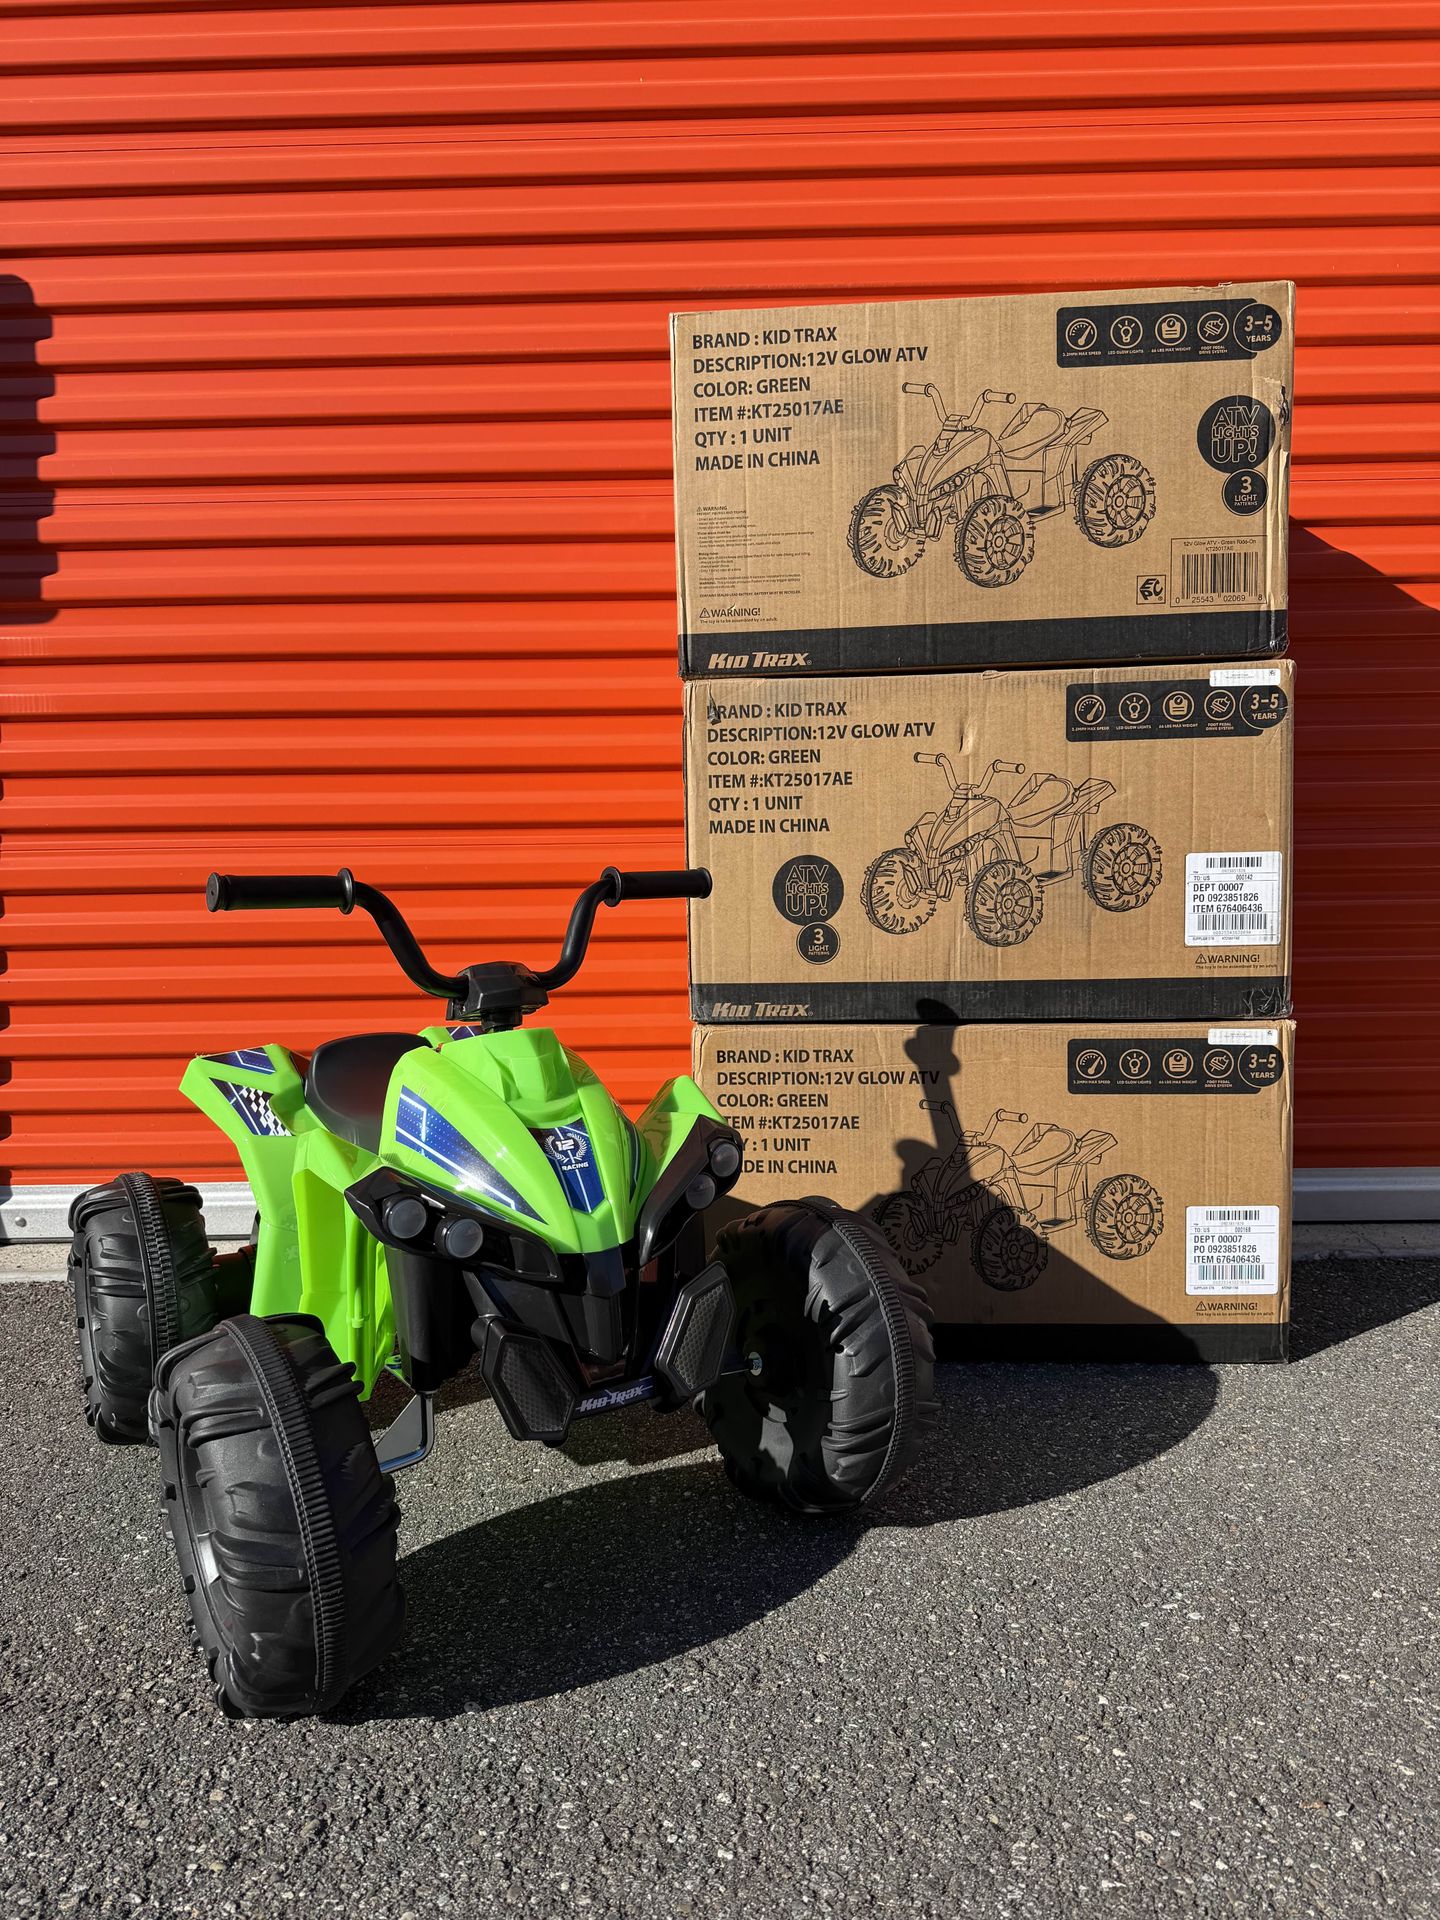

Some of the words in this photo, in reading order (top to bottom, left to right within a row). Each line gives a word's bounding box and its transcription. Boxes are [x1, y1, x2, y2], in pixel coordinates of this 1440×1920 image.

[1244, 314, 1273, 332] 3-5
[692, 332, 750, 350] BRAND
[762, 329, 791, 346] KID
[794, 326, 837, 344] TRAX
[1246, 334, 1272, 342] YEARS
[693, 350, 838, 374] DESCRIPTION:12V
[842, 348, 892, 365] GLOW
[896, 346, 928, 362] ATV
[693, 380, 753, 398] COLOR:
[756, 376, 811, 394] GREEN
[694, 405, 733, 422] ITEM
[737, 399, 844, 420] #:KT25017AE
[1212, 404, 1260, 426] ATV
[694, 430, 727, 448] QTY
[740, 430, 747, 444] 1
[752, 426, 792, 443] UNIT
[1212, 424, 1260, 439] LIGHTS
[1212, 438, 1258, 464] UP!
[695, 454, 744, 471] MADE
[748, 452, 764, 468] IN
[768, 450, 820, 468] CHINA
[1240, 476, 1252, 494] 3
[1234, 494, 1258, 502] LIGHT
[710, 607, 760, 618] WARNING!
[1250, 693, 1279, 710] 3-5
[774, 702, 802, 718] KID
[805, 701, 847, 717] TRAX
[1252, 712, 1278, 720] YEARS
[707, 724, 848, 742] DESCRIPTION:12V
[851, 723, 900, 739] GLOW
[902, 722, 936, 738] ATV
[707, 750, 765, 766] COLOR:
[768, 748, 821, 764] GREEN
[708, 774, 746, 789] ITEM
[750, 771, 853, 788] #:KT25017AE
[708, 797, 740, 813] QTY
[752, 797, 759, 811] 1
[764, 796, 803, 810] UNIT
[709, 819, 756, 834] MADE
[759, 819, 775, 833] IN
[779, 818, 830, 833] CHINA
[786, 864, 829, 883] ATV
[786, 882, 829, 895] LIGHTS
[1193, 883, 1216, 892] DEPT
[1218, 883, 1244, 892] 00007
[785, 894, 828, 917] UP!
[1193, 894, 1205, 903] PO
[1207, 893, 1259, 902] 0923851826
[1193, 904, 1214, 913] ITEM
[1216, 904, 1263, 913] 676406436
[813, 928, 824, 945] 3
[1207, 954, 1260, 963] WARNING!
[716, 1050, 772, 1064] BRAND
[783, 1050, 810, 1063] KID
[812, 1049, 854, 1063] TRAX
[1248, 1053, 1277, 1069] 3-5
[717, 1071, 854, 1086] DESCRIPTION:12V
[858, 1071, 905, 1085] GLOW
[908, 1070, 940, 1085] ATV
[1250, 1071, 1275, 1079] YEARS
[717, 1093, 774, 1108] COLOR:
[777, 1093, 828, 1108] GREEN
[758, 1116, 860, 1130] #:KT25017AE
[555, 1139, 575, 1151] 12
[761, 1138, 767, 1151] 1
[773, 1138, 810, 1151] UNIT
[562, 1162, 589, 1171] RACING
[741, 1160, 764, 1173] DE
[768, 1160, 784, 1173] IN
[788, 1160, 837, 1174] CHINA
[1194, 1235, 1216, 1244] DEPT
[1218, 1235, 1243, 1243] 00007
[1194, 1246, 1205, 1254] PO
[1208, 1245, 1257, 1253] 0923851826
[1193, 1256, 1214, 1264] ITEM
[1216, 1255, 1261, 1263] 676406436
[1207, 1302, 1258, 1311] WARNING!
